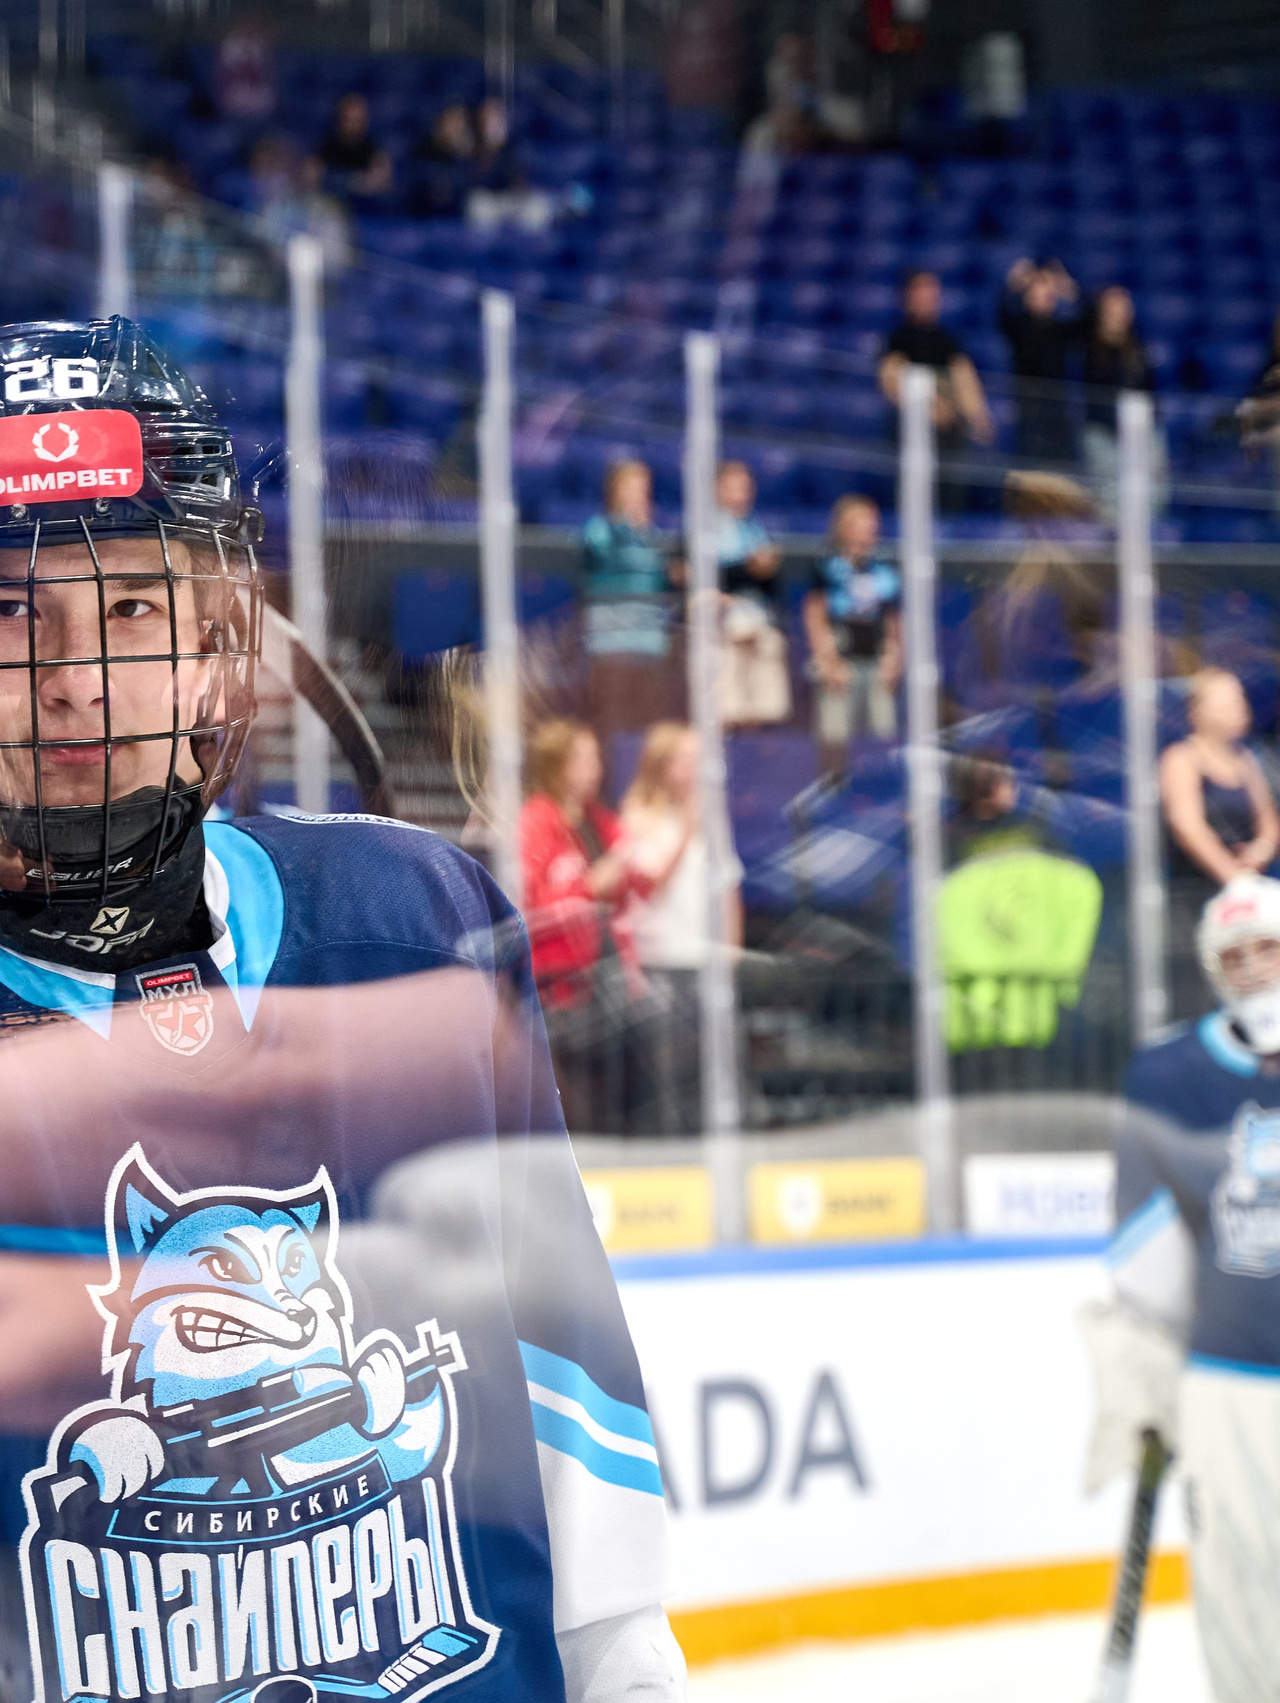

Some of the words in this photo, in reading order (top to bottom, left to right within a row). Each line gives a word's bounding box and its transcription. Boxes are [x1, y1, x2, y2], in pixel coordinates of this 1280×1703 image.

[3, 356, 100, 402] 26
[145, 980, 199, 1004] МХЛ
[146, 972, 191, 986] OLIMPBET
[143, 1473, 371, 1534] СИБИРСКИЕ
